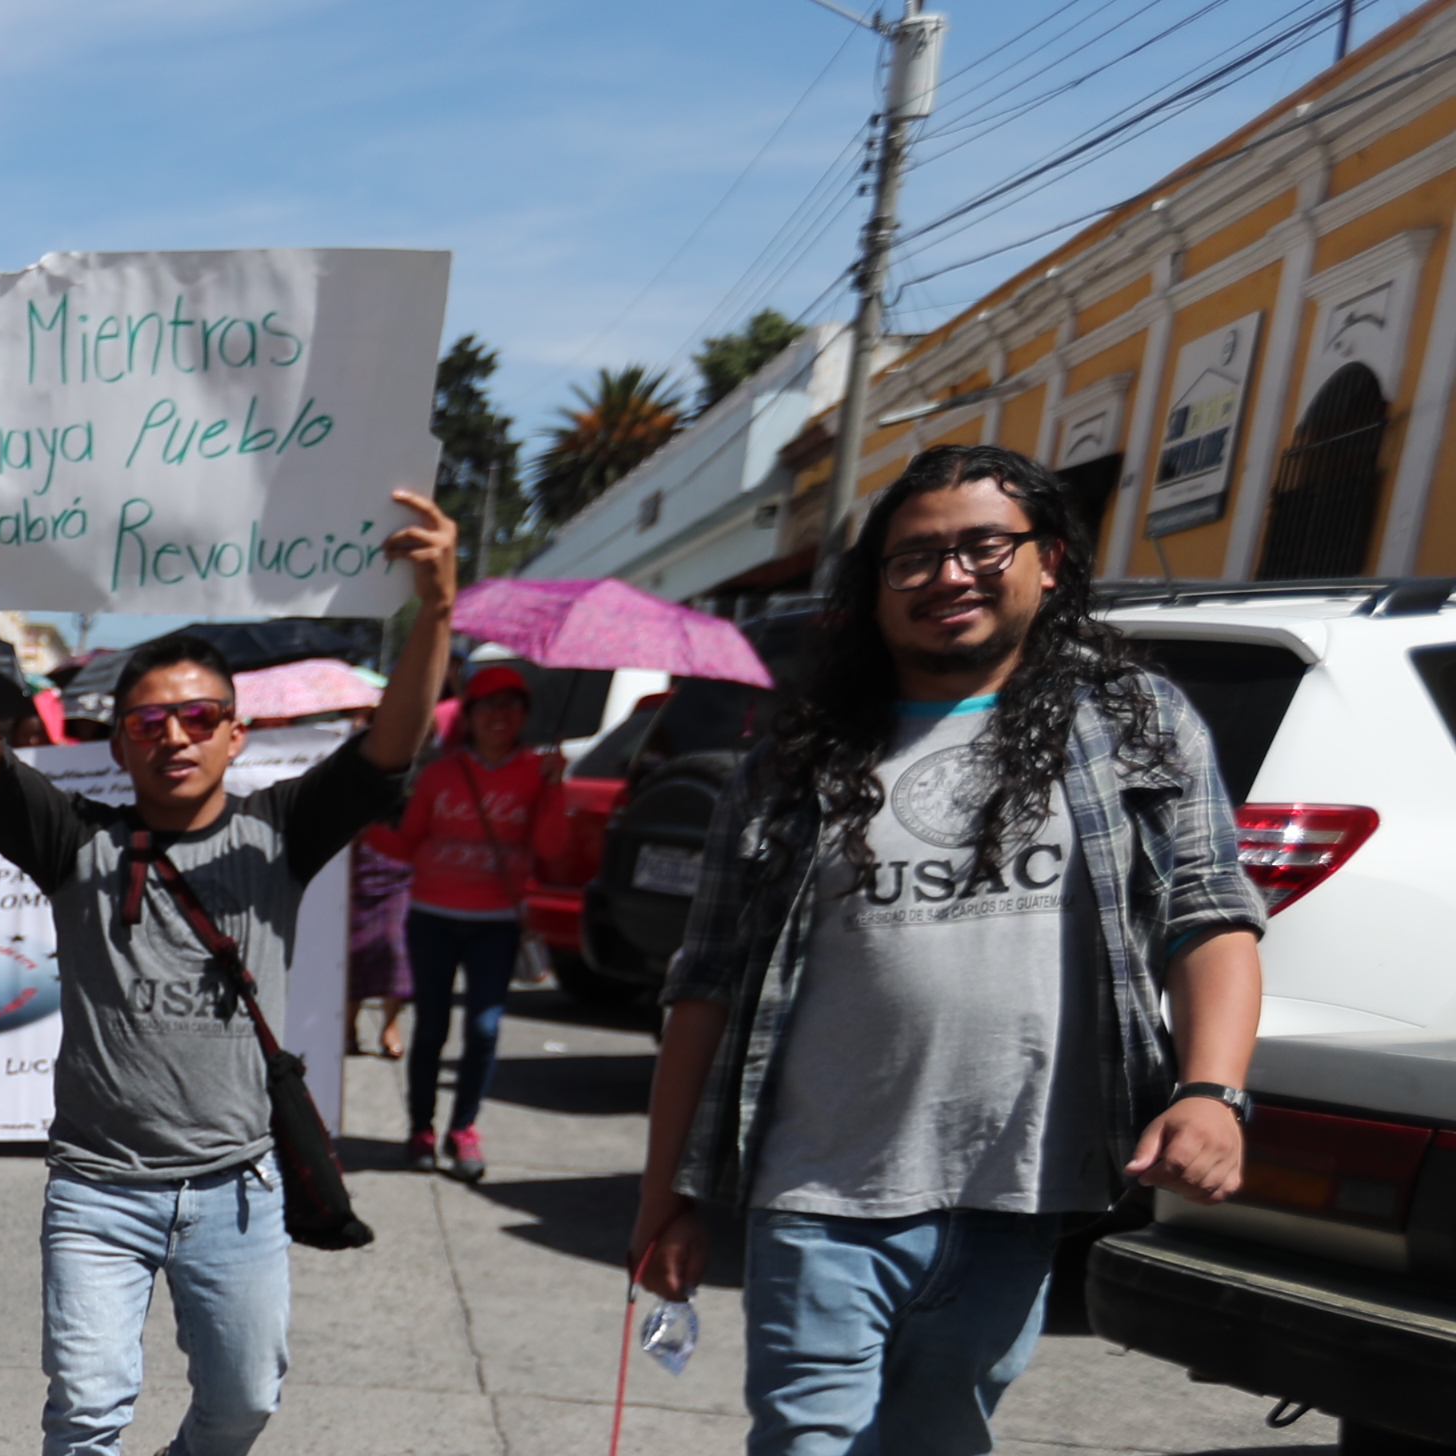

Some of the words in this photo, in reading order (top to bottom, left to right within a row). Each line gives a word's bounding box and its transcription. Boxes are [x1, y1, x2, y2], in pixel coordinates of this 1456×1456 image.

[27, 293, 304, 384] Mientras
[125, 396, 335, 468] Pueblo
[111, 497, 393, 593] Revolución
[864, 844, 1063, 906] USAC
[909, 909, 923, 922] DE
[951, 901, 997, 919] CARLOS
[998, 898, 1014, 911] DE
[5, 1058, 56, 1076] LUC
